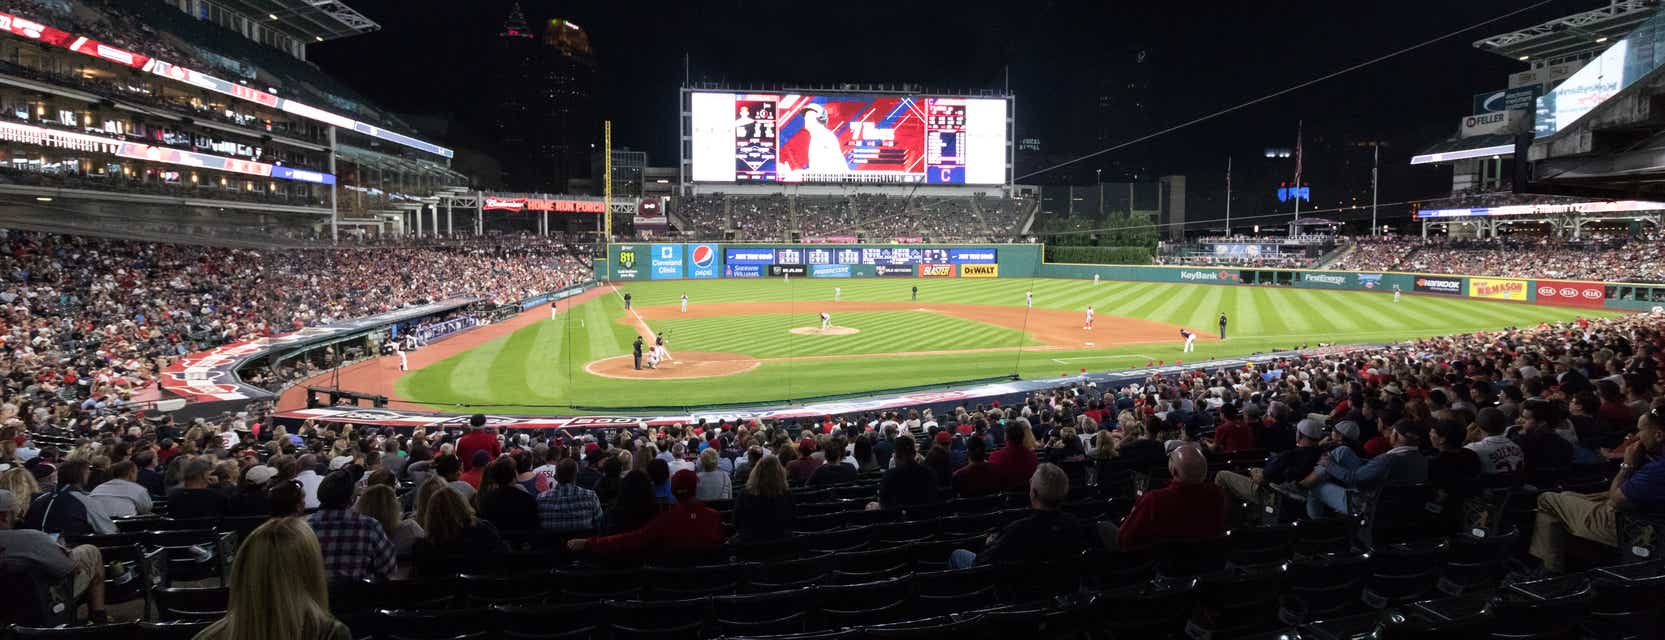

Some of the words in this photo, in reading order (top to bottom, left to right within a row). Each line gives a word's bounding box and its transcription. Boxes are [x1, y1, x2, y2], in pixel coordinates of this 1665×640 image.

[1477, 113, 1504, 126] FELLER
[528, 200, 555, 211] HOME
[556, 201, 574, 212] RUN
[576, 201, 605, 213] PORCH
[620, 252, 634, 263] 811
[695, 269, 713, 277] pepsi
[1181, 271, 1218, 280] KeyBank
[1305, 273, 1345, 284] FirstEnergy
